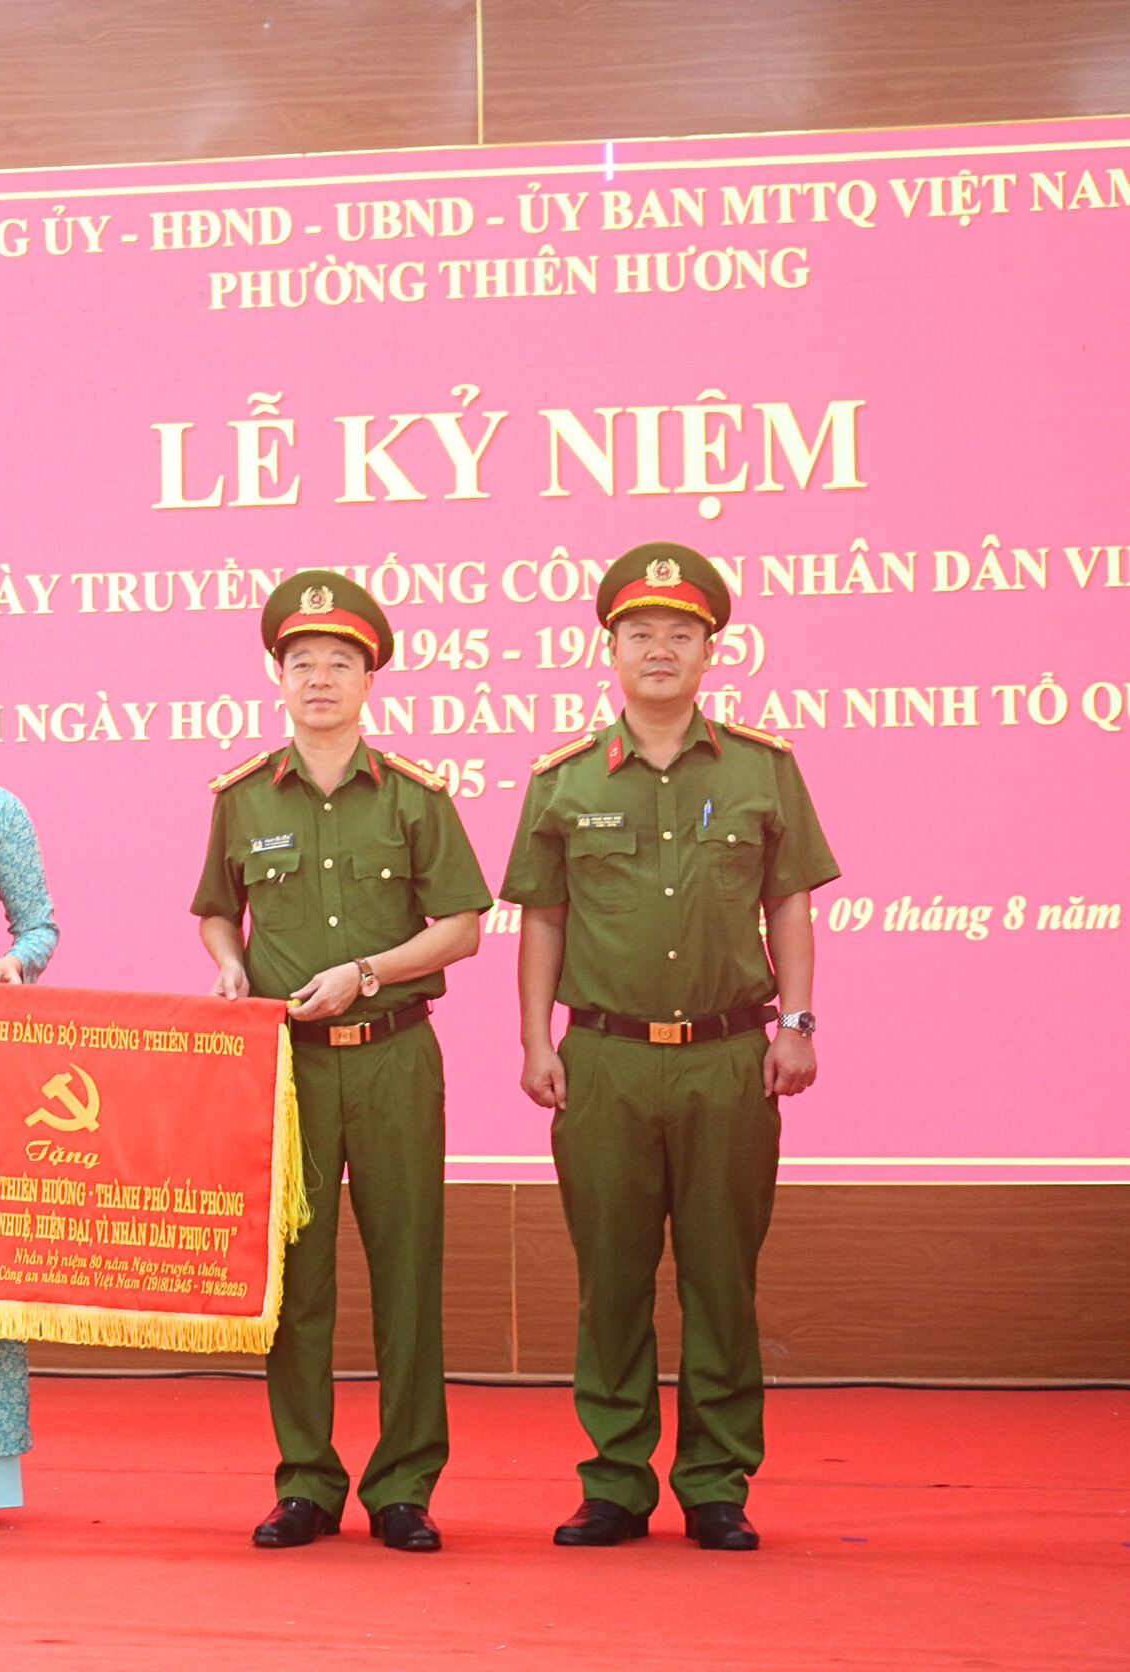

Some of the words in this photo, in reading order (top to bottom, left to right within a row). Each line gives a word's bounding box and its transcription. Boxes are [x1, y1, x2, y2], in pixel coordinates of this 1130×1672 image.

[41, 204, 112, 256] ỦY
[120, 234, 138, 243] -
[149, 206, 293, 251] HĐND
[304, 225, 322, 234] -
[333, 197, 474, 242] UBND
[486, 216, 505, 225] -
[516, 181, 589, 234] ỦY
[599, 187, 707, 230] BAN
[719, 179, 877, 228] MTTQ
[888, 169, 1017, 227] VIỆT
[208, 253, 428, 310] PHƯỜNG
[438, 243, 599, 300] THIÊN
[614, 244, 810, 294] HƯƠNG
[150, 391, 301, 509] LỄ
[333, 383, 509, 503] KỶ
[538, 388, 867, 520] NIỆM
[70, 557, 283, 613] TRUYỀN
[296, 552, 489, 609] ỐNG
[501, 545, 617, 603] CÔN
[759, 537, 917, 596] NHÂN
[931, 533, 1049, 592] DÂN
[1063, 545, 1130, 588] VI
[14, 691, 158, 743] NGÀY
[167, 693, 263, 750] HỘI
[274, 695, 417, 738] TN
[429, 681, 538, 735] DÂN
[551, 680, 617, 737] BẢ
[754, 688, 829, 730] AN
[842, 685, 979, 728] NINH
[991, 671, 1068, 725] TỔ
[828, 897, 874, 932] 09
[883, 895, 993, 940] tháng
[1003, 895, 1027, 930] 8
[1036, 895, 1121, 930] năm
[11, 1013, 55, 1045] ĐẢNG
[56, 1020, 77, 1051] BỘ
[79, 1021, 140, 1051] PHƯỜNG
[142, 1025, 189, 1053] THIÊN
[192, 1030, 245, 1057] HƯƠNG
[25, 1139, 100, 1169] Tặng
[40, 1175, 87, 1207] HƯƠNG
[95, 1178, 142, 1210] THÀNH
[142, 1176, 171, 1212] PHỐ
[173, 1178, 198, 1214] HẢI
[199, 1183, 245, 1217] PHÒNG
[35, 1210, 66, 1244] HIỆN
[68, 1218, 93, 1246] ĐẠI,
[95, 1214, 109, 1244] VÌ
[110, 1216, 148, 1246] NHÂN
[150, 1218, 176, 1248] DÂN
[178, 1226, 210, 1256] PHỤC
[14, 1248, 44, 1265] Nhân
[46, 1250, 59, 1269] kỷ
[61, 1253, 87, 1270] niệm
[89, 1255, 102, 1270] 80
[104, 1257, 129, 1271] năm
[131, 1257, 158, 1276] Ngày
[197, 1260, 228, 1280] thống
[25, 1271, 38, 1282] an
[41, 1268, 68, 1284] nhân
[70, 1270, 90, 1286] dân
[93, 1272, 114, 1288] Việt
[115, 1275, 140, 1289] Nam
